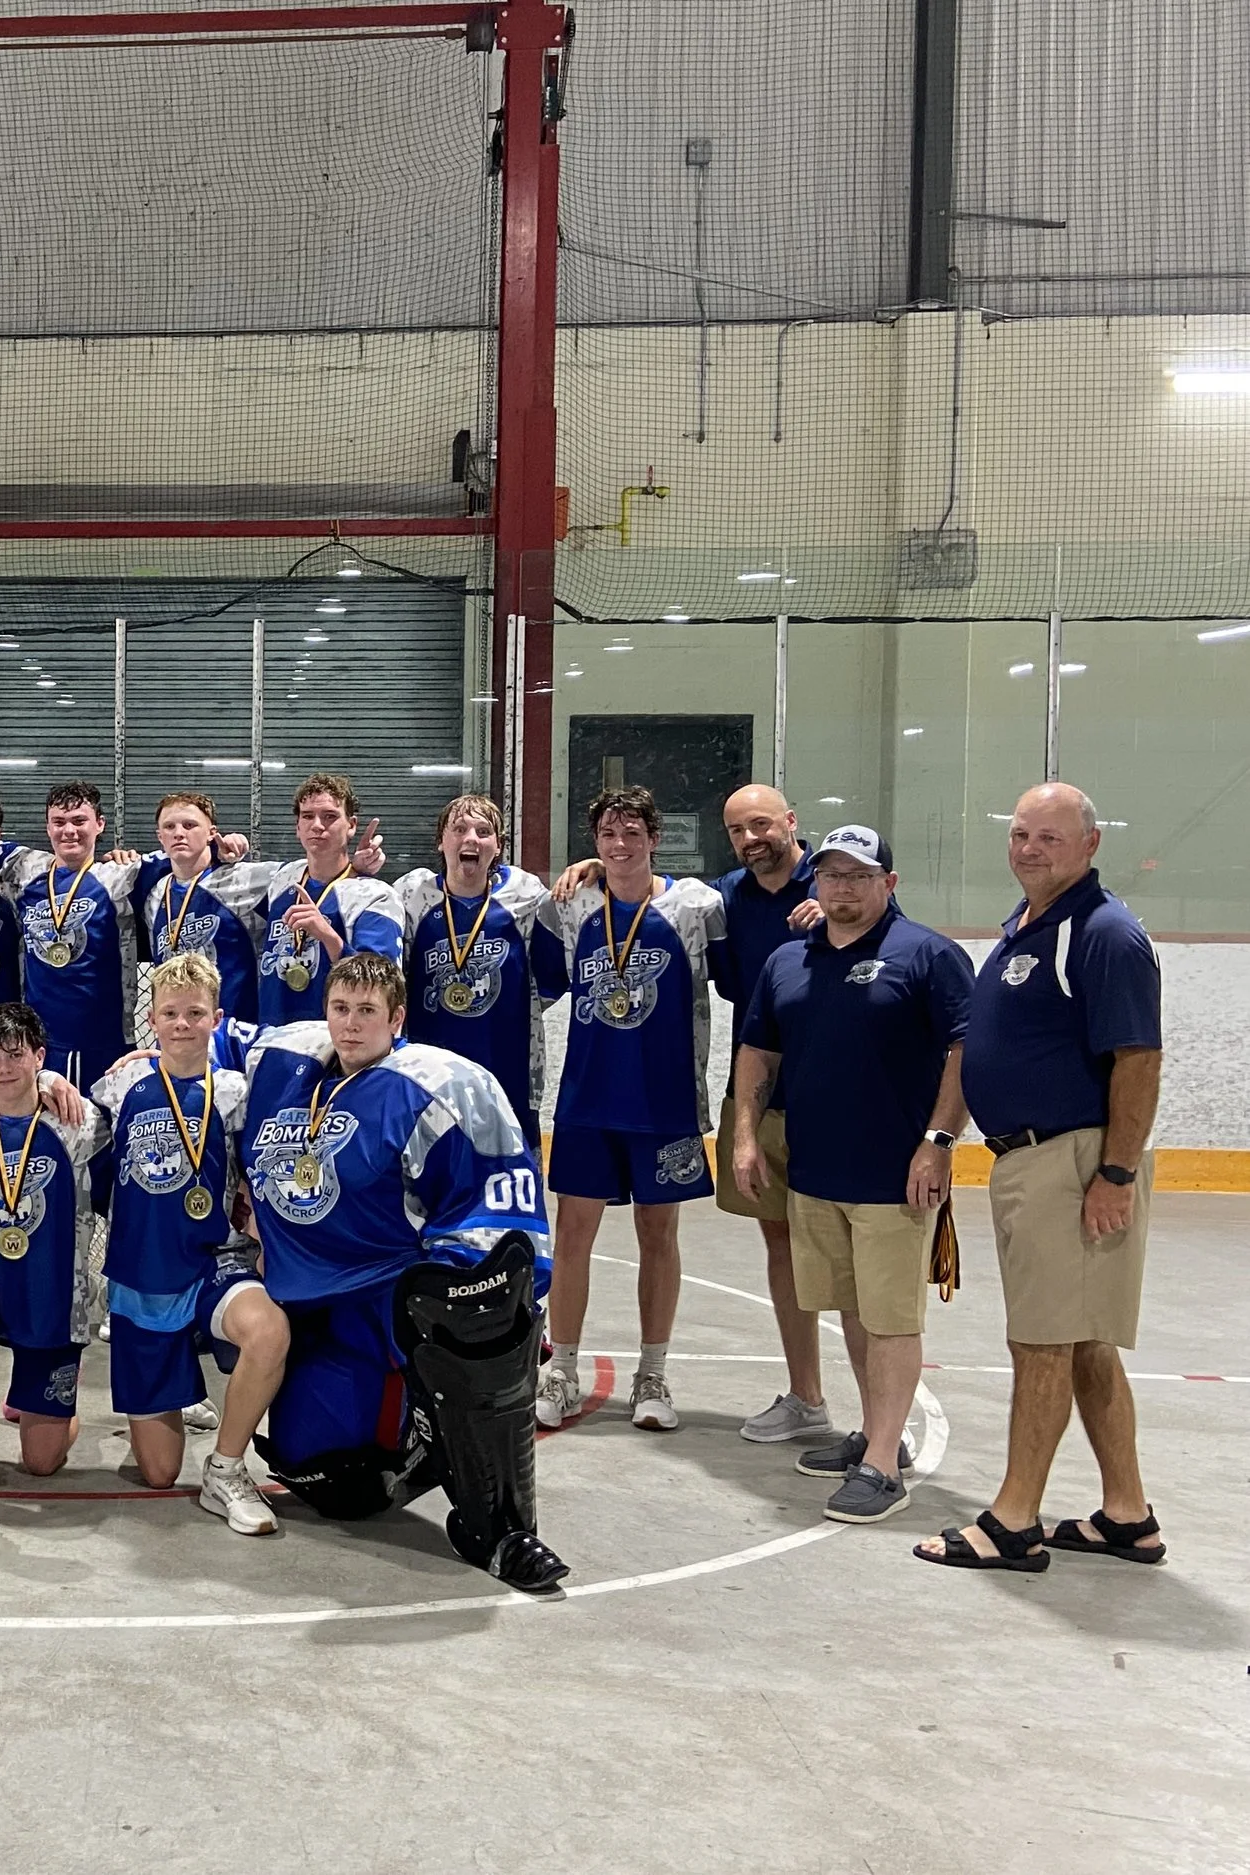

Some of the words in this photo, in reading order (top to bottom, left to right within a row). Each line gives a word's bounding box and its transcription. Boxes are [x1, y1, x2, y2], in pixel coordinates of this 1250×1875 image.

[157, 916, 213, 954] BOBERS
[583, 951, 661, 979] BOMERS
[128, 1120, 199, 1140] BOMBES
[276, 1186, 335, 1218] LACROSSE
[485, 1168, 536, 1214] 00
[447, 1271, 508, 1298] BODDAM
